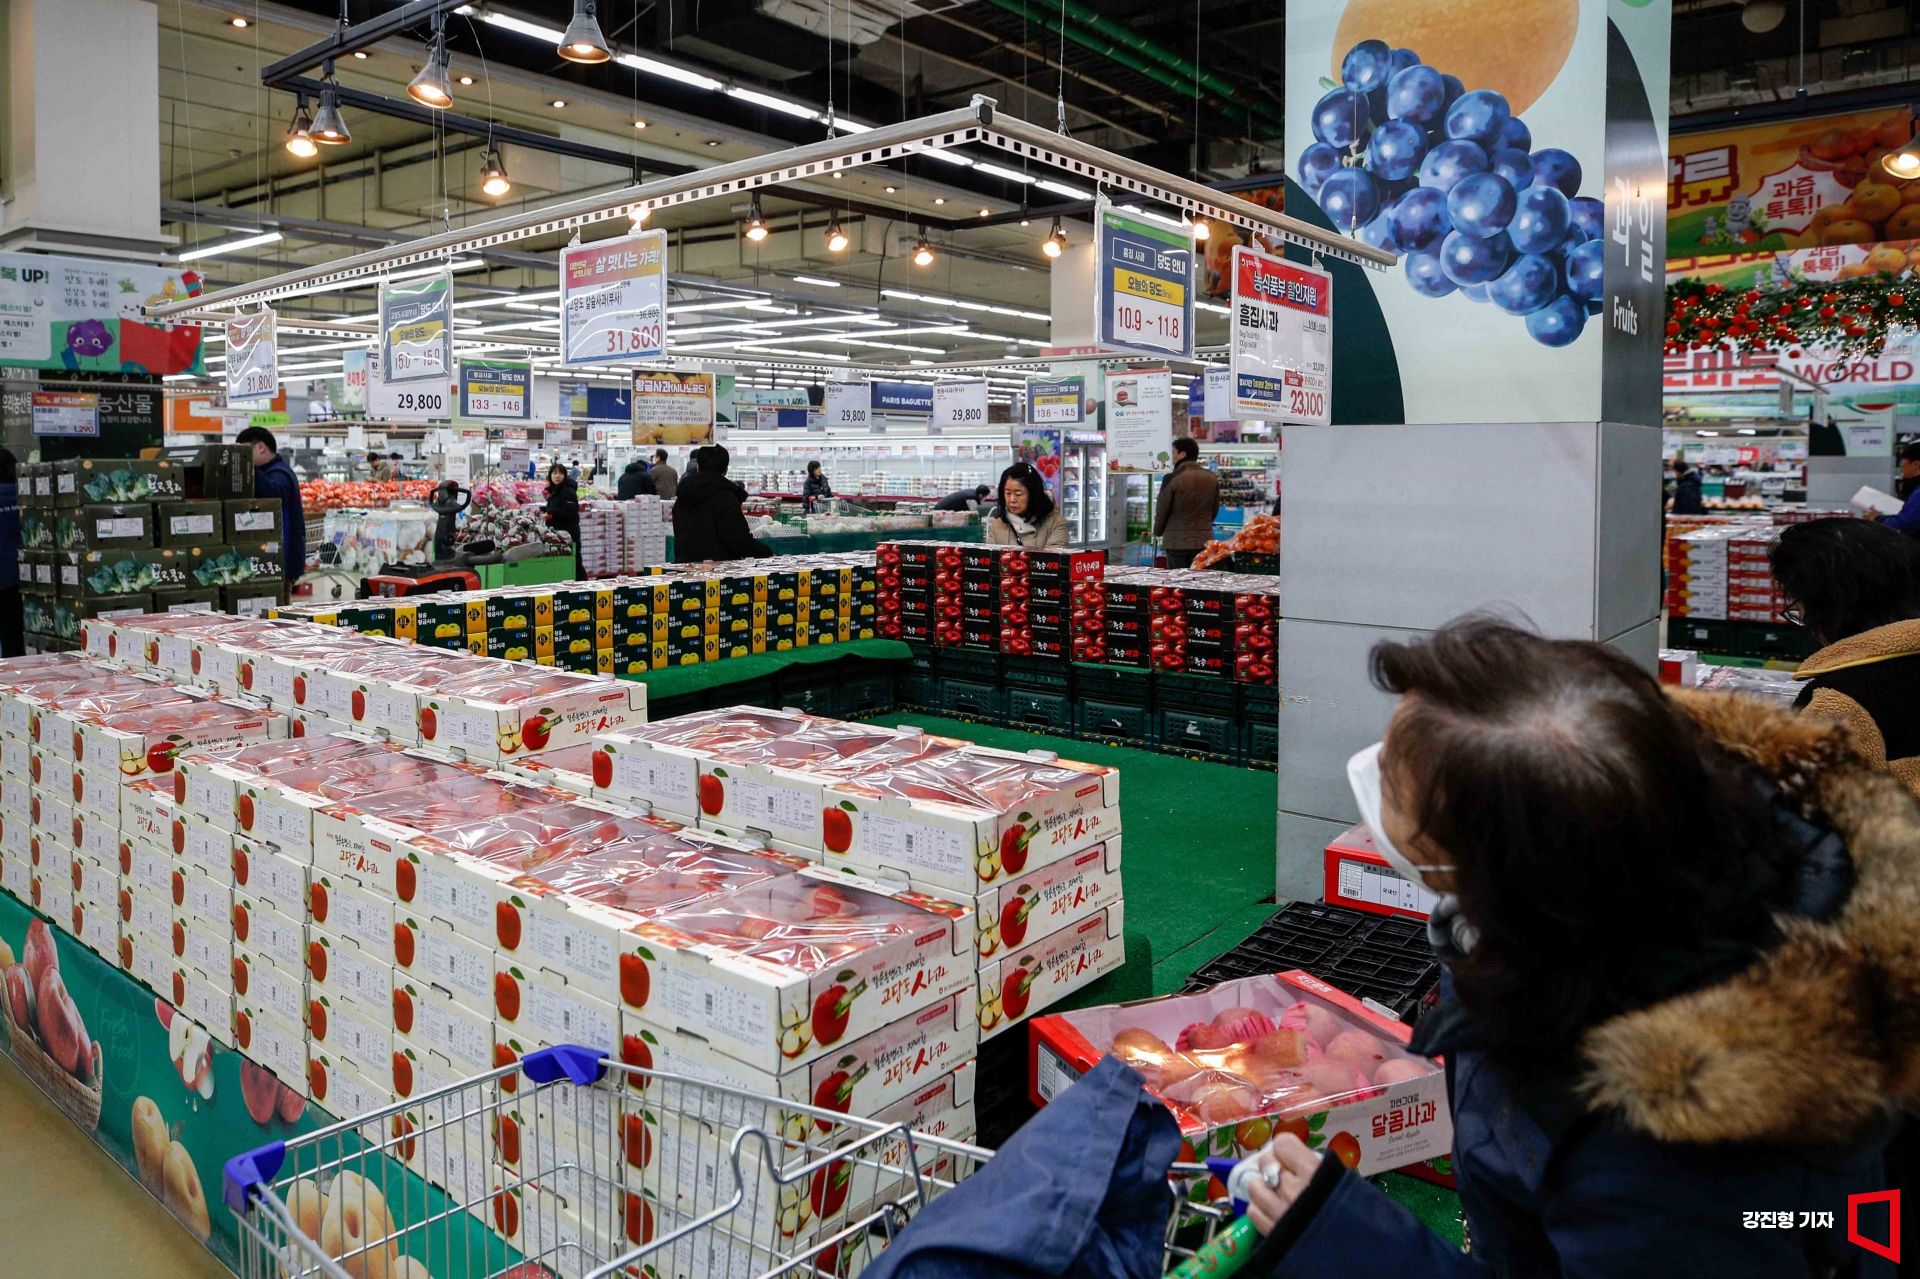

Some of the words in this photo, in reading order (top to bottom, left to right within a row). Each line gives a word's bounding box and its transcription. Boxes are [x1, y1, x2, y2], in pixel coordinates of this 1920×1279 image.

[1772, 175, 1816, 198] 과즙
[1765, 193, 1822, 220] 톡톡!!
[1612, 175, 1654, 284] 과일
[22, 268, 50, 284] UP!
[1157, 253, 1171, 271] 당도
[1171, 258, 1186, 276] 안내
[1128, 276, 1149, 294] 오늘의
[1253, 270, 1286, 298] 농식품부
[1287, 280, 1317, 307] 할인지원
[1118, 306, 1142, 331] 10.9
[1158, 315, 1179, 339] 11.8
[1240, 303, 1279, 333] 흠집사과
[1613, 295, 1638, 336] Fruits
[607, 324, 660, 353] 31,800
[247, 373, 273, 392] 31,800
[1794, 360, 1914, 384] WORLD
[99, 393, 153, 414] 농산물
[397, 393, 442, 411] 29,800
[471, 399, 489, 410] 13.3
[502, 400, 520, 411] 14.6
[882, 396, 900, 405] PARIS
[901, 397, 932, 406] BAGUETTE
[1290, 389, 1324, 417] 23,100
[841, 409, 866, 422] 29,800
[952, 408, 981, 422] 29,800
[1371, 1099, 1437, 1139] 달콤사과
